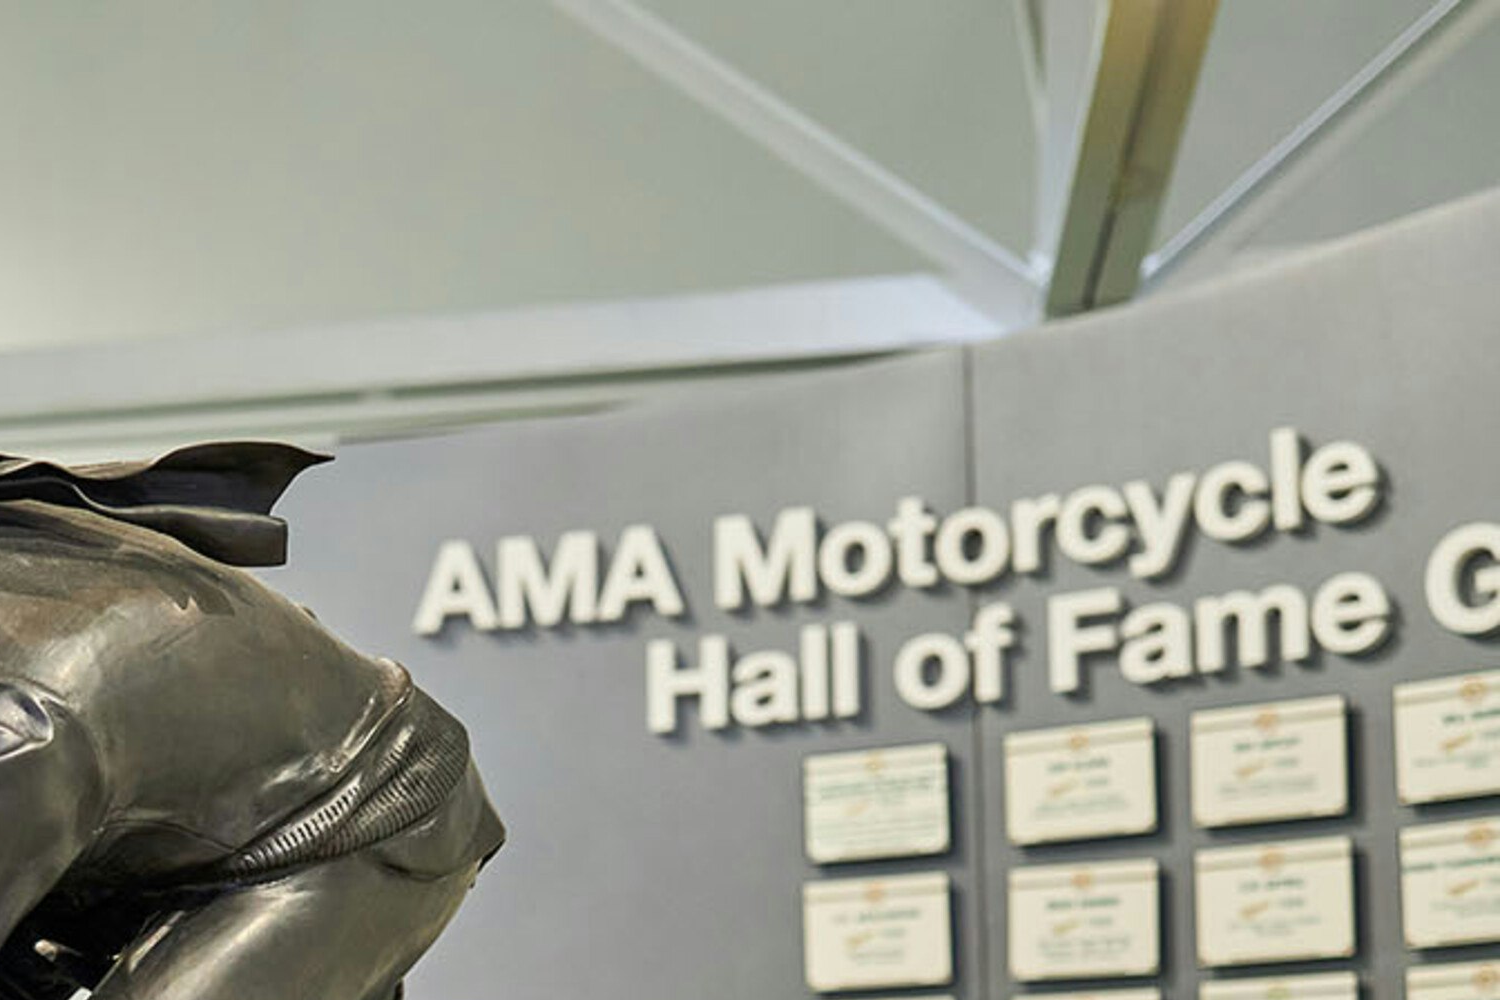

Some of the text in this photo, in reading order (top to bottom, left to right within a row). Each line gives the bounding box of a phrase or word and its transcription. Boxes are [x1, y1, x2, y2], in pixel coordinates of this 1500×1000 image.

[411, 425, 1377, 634] AMA Motorcycle
[646, 620, 858, 733] Hall
[893, 601, 1012, 709] of
[1047, 571, 1388, 693] Fame
